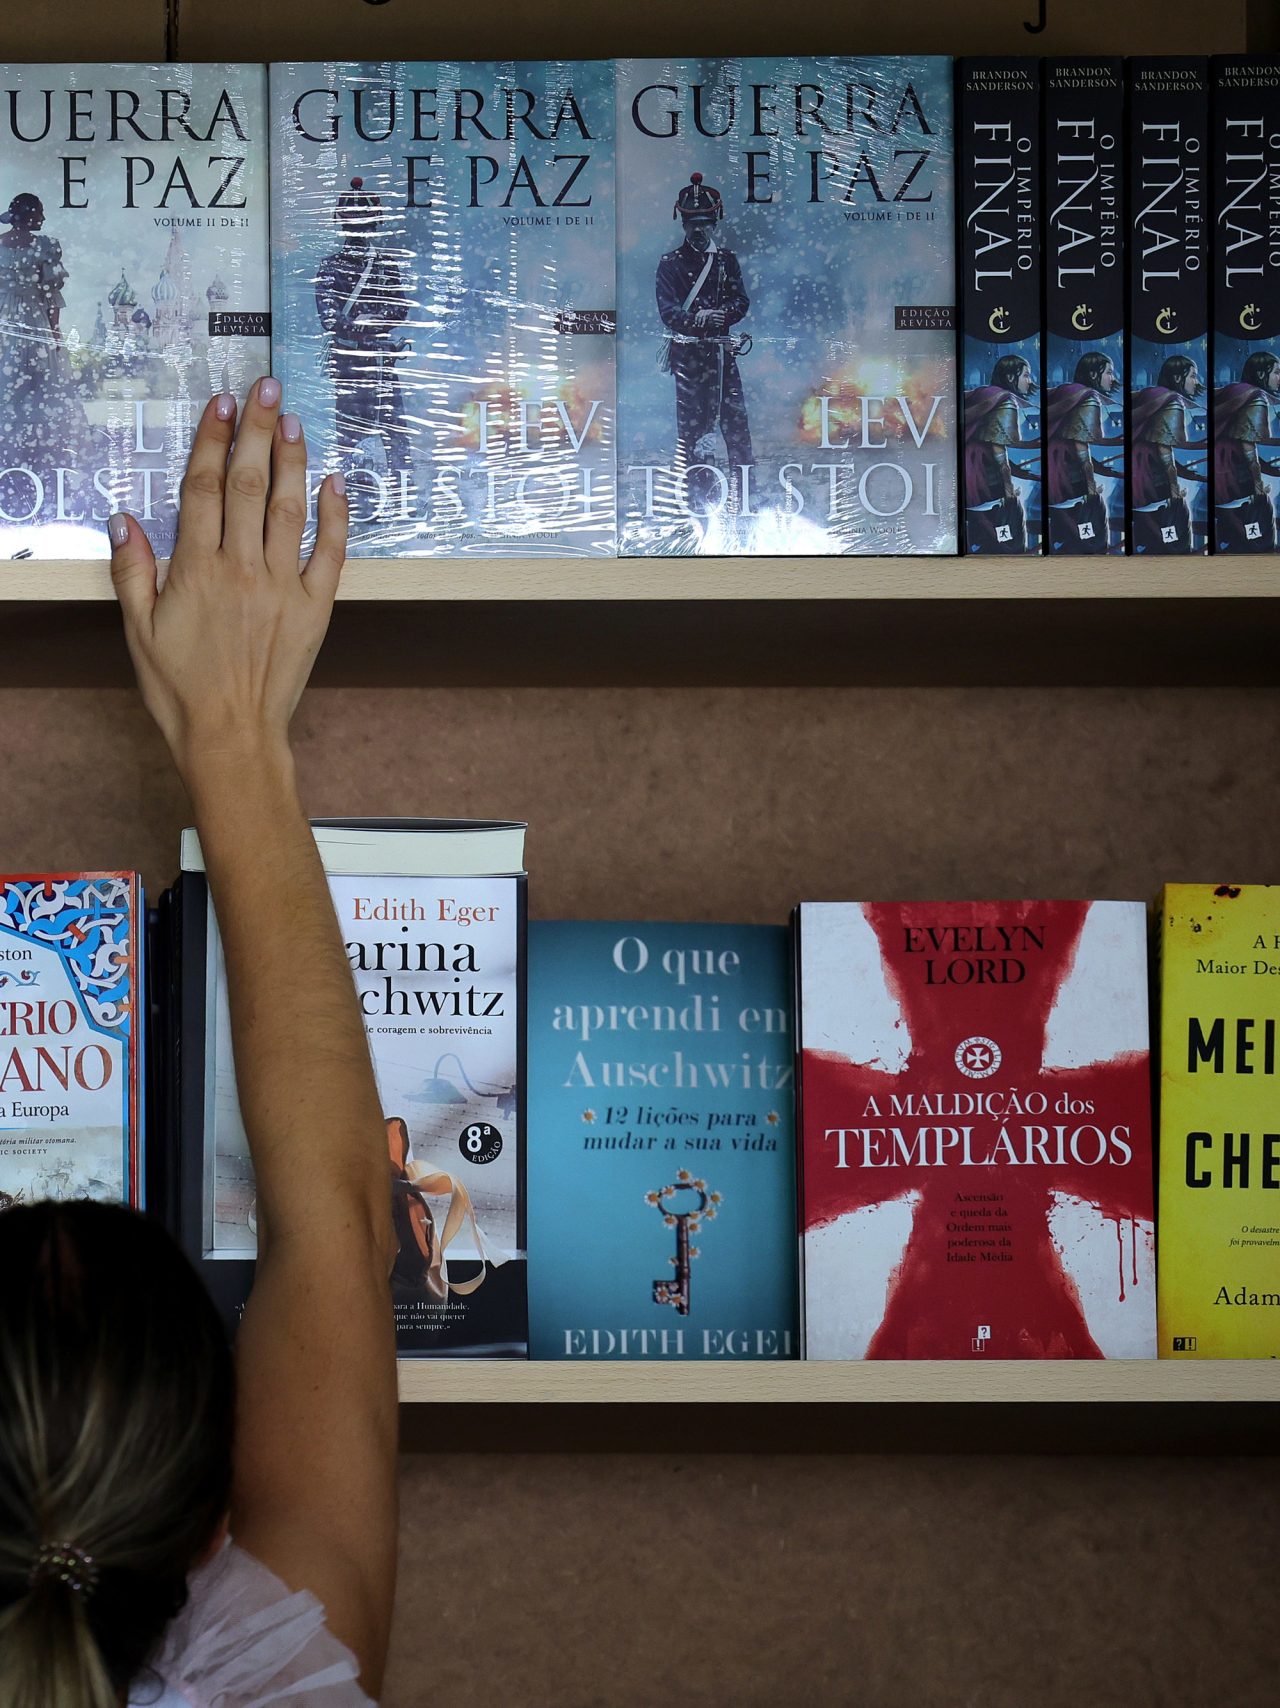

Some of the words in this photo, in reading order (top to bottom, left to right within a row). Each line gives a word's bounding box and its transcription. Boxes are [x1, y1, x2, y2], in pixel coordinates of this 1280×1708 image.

[972, 70, 1028, 80] BRANDON
[1049, 79, 1118, 89] SANDERSON
[1055, 67, 1111, 78] BRANDON
[1141, 70, 1197, 80] BRANDON
[966, 82, 1034, 92] SANDERSON
[1134, 81, 1203, 91] SANDERSON
[292, 87, 597, 143] GUERRA
[630, 82, 936, 139] GUERRA
[1016, 136, 1032, 153] O
[1100, 134, 1115, 150] O
[58, 156, 89, 209] E
[121, 155, 248, 209] PAZ
[402, 155, 433, 208] E
[465, 154, 593, 208] PAZ
[742, 151, 774, 204] E
[806, 149, 934, 204] PAZ
[966, 119, 1017, 293] FINAL
[1050, 116, 1099, 290] FINAL
[1134, 120, 1184, 292] FINAL
[1218, 116, 1268, 288] FINAL
[154, 218, 202, 228] VOLUME
[503, 216, 552, 226] VOLUME
[844, 211, 893, 221] VOLUME
[1016, 166, 1036, 271] IMPÉRIO
[1100, 163, 1119, 268] IMPÉRIO
[1185, 167, 1204, 271] IMPÉRIO
[900, 319, 952, 328] REVISTA
[902, 307, 951, 319] EDIÇÃO
[214, 325, 266, 334] REVISTA
[476, 399, 604, 455] LEV
[816, 395, 949, 450] LEV
[627, 462, 940, 519] TOLSTOI
[353, 897, 425, 921] Edith
[437, 898, 500, 927] Eger
[904, 924, 1048, 954] EVELYN
[1253, 935, 1267, 949] A
[612, 936, 649, 974] O
[662, 949, 740, 985] que
[924, 958, 1027, 986] LORD
[1196, 959, 1247, 974] Maior
[552, 995, 723, 1041] aprendi
[372, 1027, 417, 1035] coragem
[428, 1025, 492, 1035] sobrevivência
[1188, 1018, 1275, 1074] MEI
[562, 1050, 795, 1090] Auschwitz
[11, 1101, 70, 1121] Europa
[862, 1095, 883, 1118] A
[890, 1087, 1048, 1122] MALDIÇÃO
[1054, 1091, 1096, 1116] dos
[604, 1106, 628, 1124] 12
[636, 1106, 699, 1128] lições
[707, 1112, 757, 1130] para
[19, 1137, 43, 1145] militar
[45, 1137, 77, 1145] otomana.
[472, 1140, 501, 1163] EDIÇÃO
[583, 1131, 657, 1150] mudar
[664, 1138, 677, 1150] a
[684, 1138, 721, 1150] sua
[731, 1133, 778, 1151] vida
[824, 1117, 1134, 1170] TEMPLÁRIOS
[955, 1191, 1004, 1202] Ascensão
[960, 1208, 992, 1219] queda
[995, 1207, 1008, 1217] da
[946, 1222, 985, 1233] Ordem
[988, 1223, 1012, 1232] mais
[947, 1237, 995, 1249] poderosa
[999, 1237, 1011, 1247] da
[947, 1252, 977, 1262] Idade
[980, 1251, 1013, 1262] Média
[1214, 1286, 1280, 1306] Adam
[563, 1329, 686, 1355] EDITH
